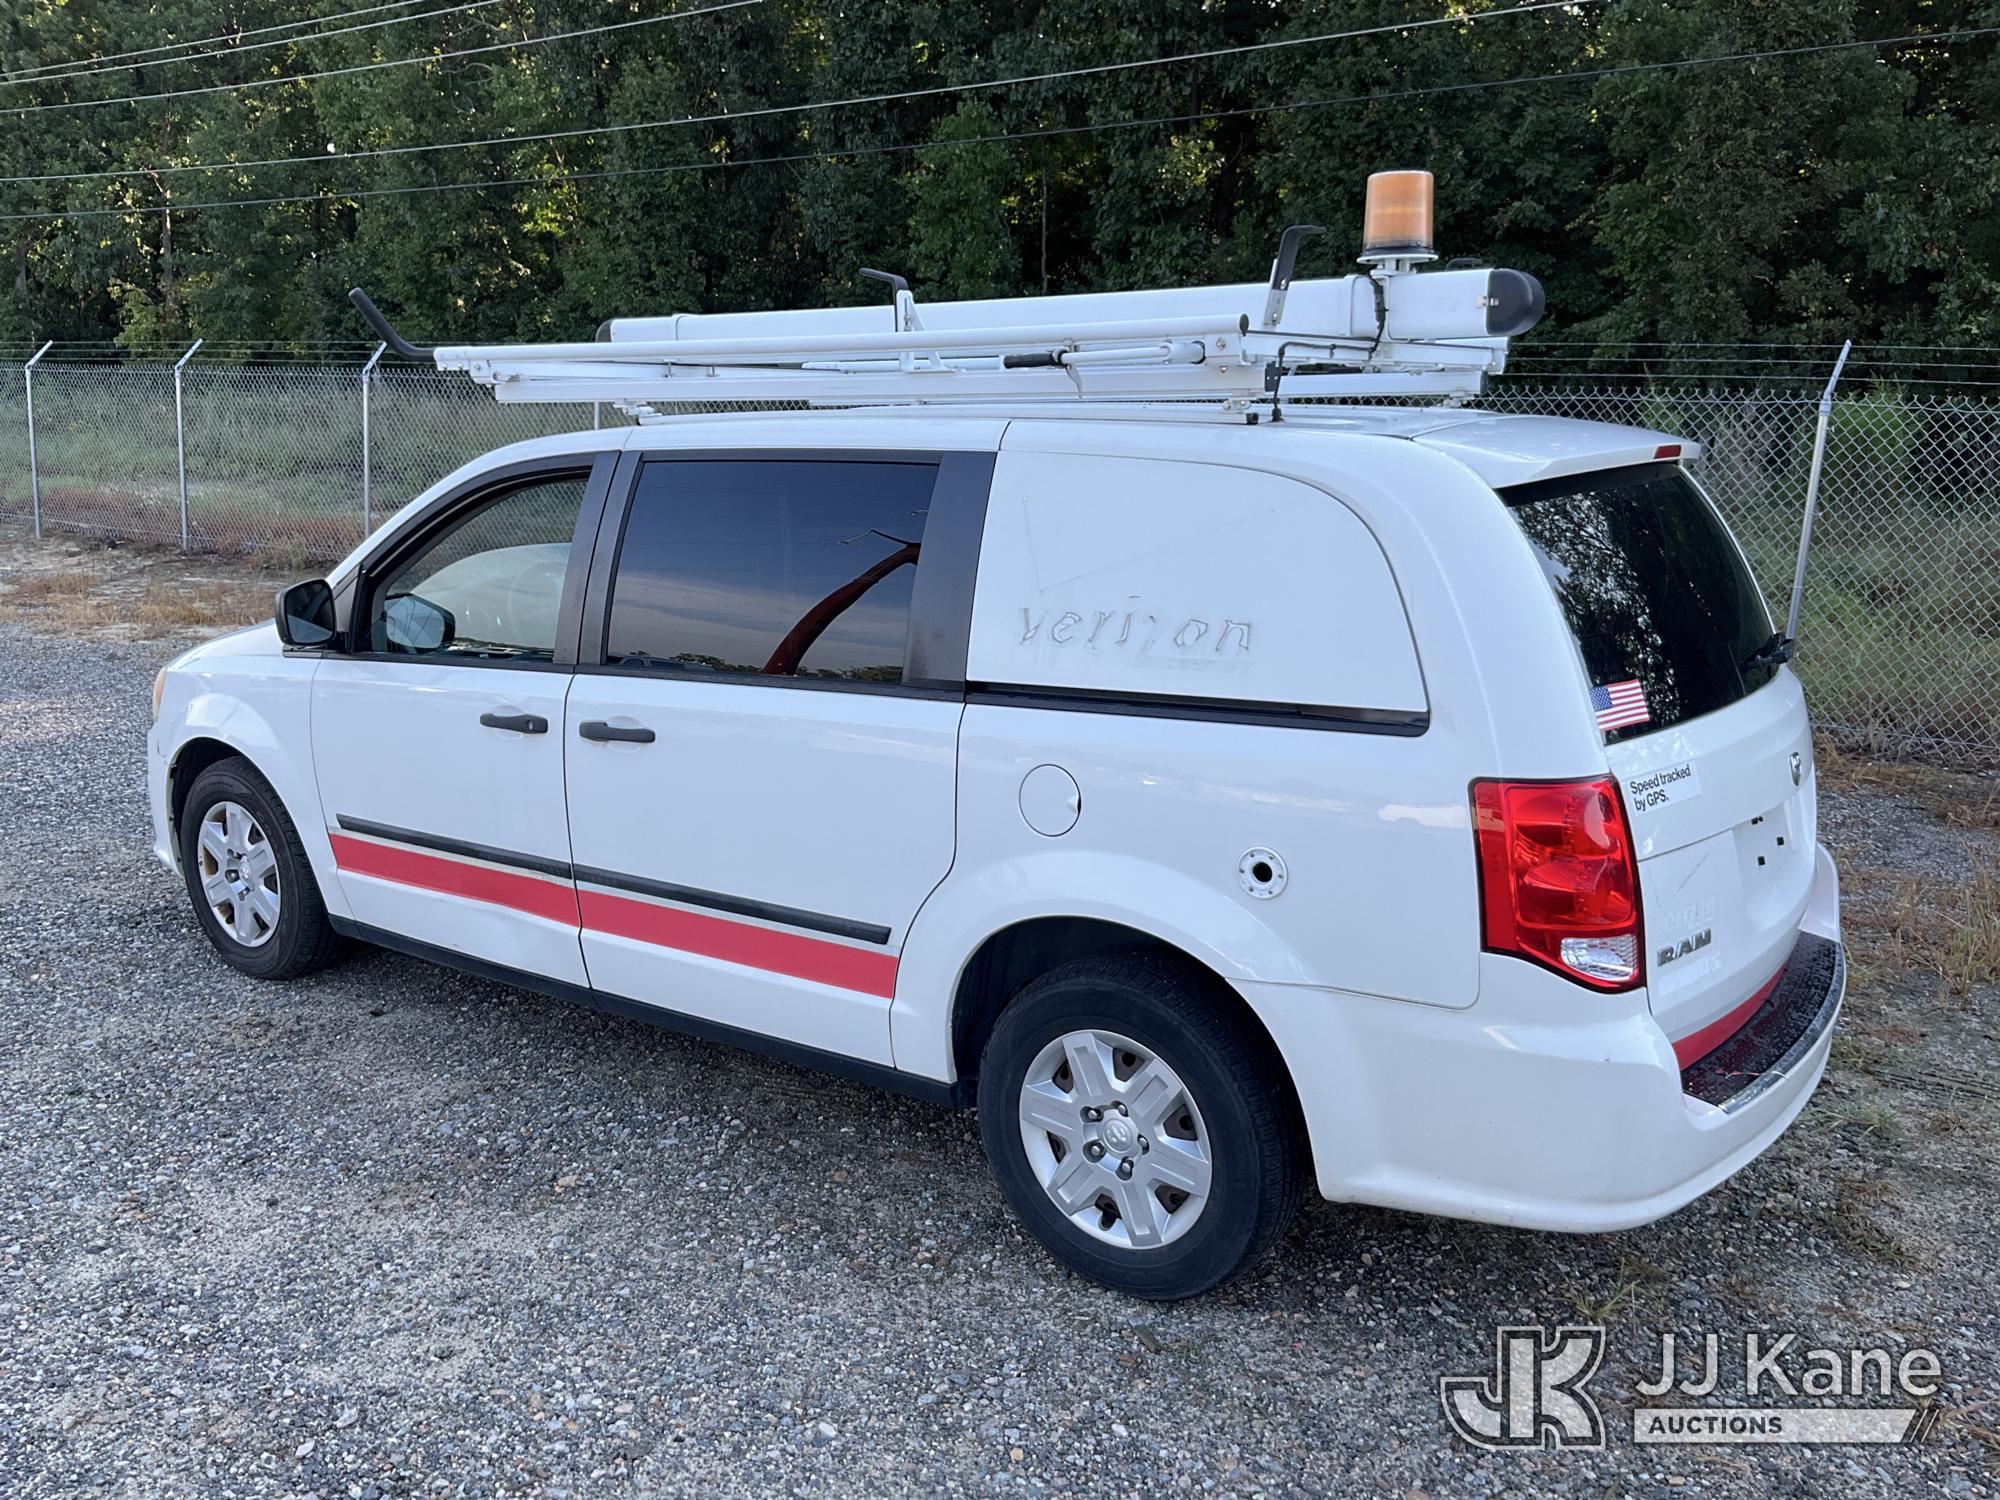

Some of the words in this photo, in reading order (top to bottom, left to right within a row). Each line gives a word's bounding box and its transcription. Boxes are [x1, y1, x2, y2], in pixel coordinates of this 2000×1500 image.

[1018, 595, 1254, 654] verion
[1630, 774, 1660, 796] Speed
[1659, 763, 1692, 785] tracked
[1634, 797, 1646, 812] by
[1646, 789, 1669, 806] GPS.
[1657, 928, 1712, 966] RAM
